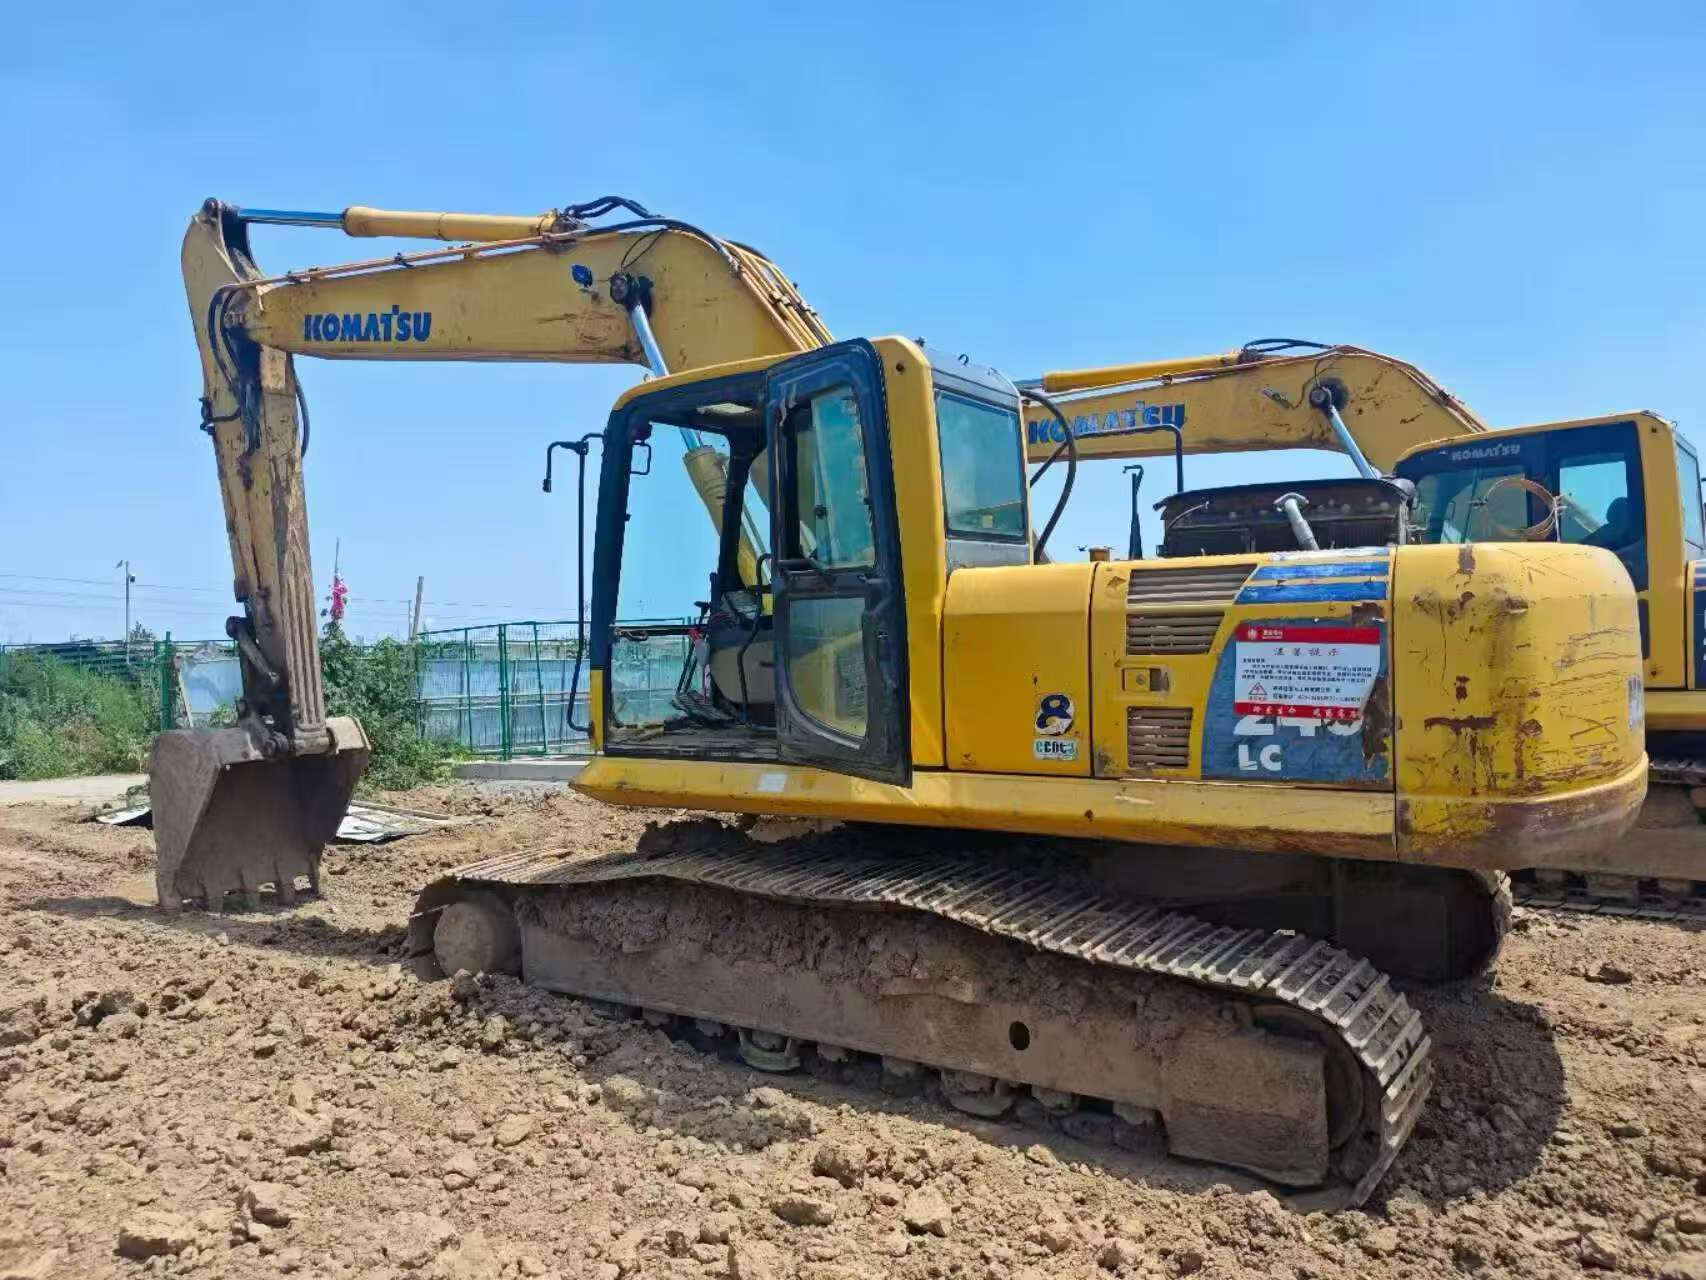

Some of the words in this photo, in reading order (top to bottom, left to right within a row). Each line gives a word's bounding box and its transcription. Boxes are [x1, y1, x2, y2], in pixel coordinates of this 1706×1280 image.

[304, 305, 432, 342] KOMATSU
[1452, 443, 1521, 461] KOMATSU
[1238, 744, 1282, 772] LC
